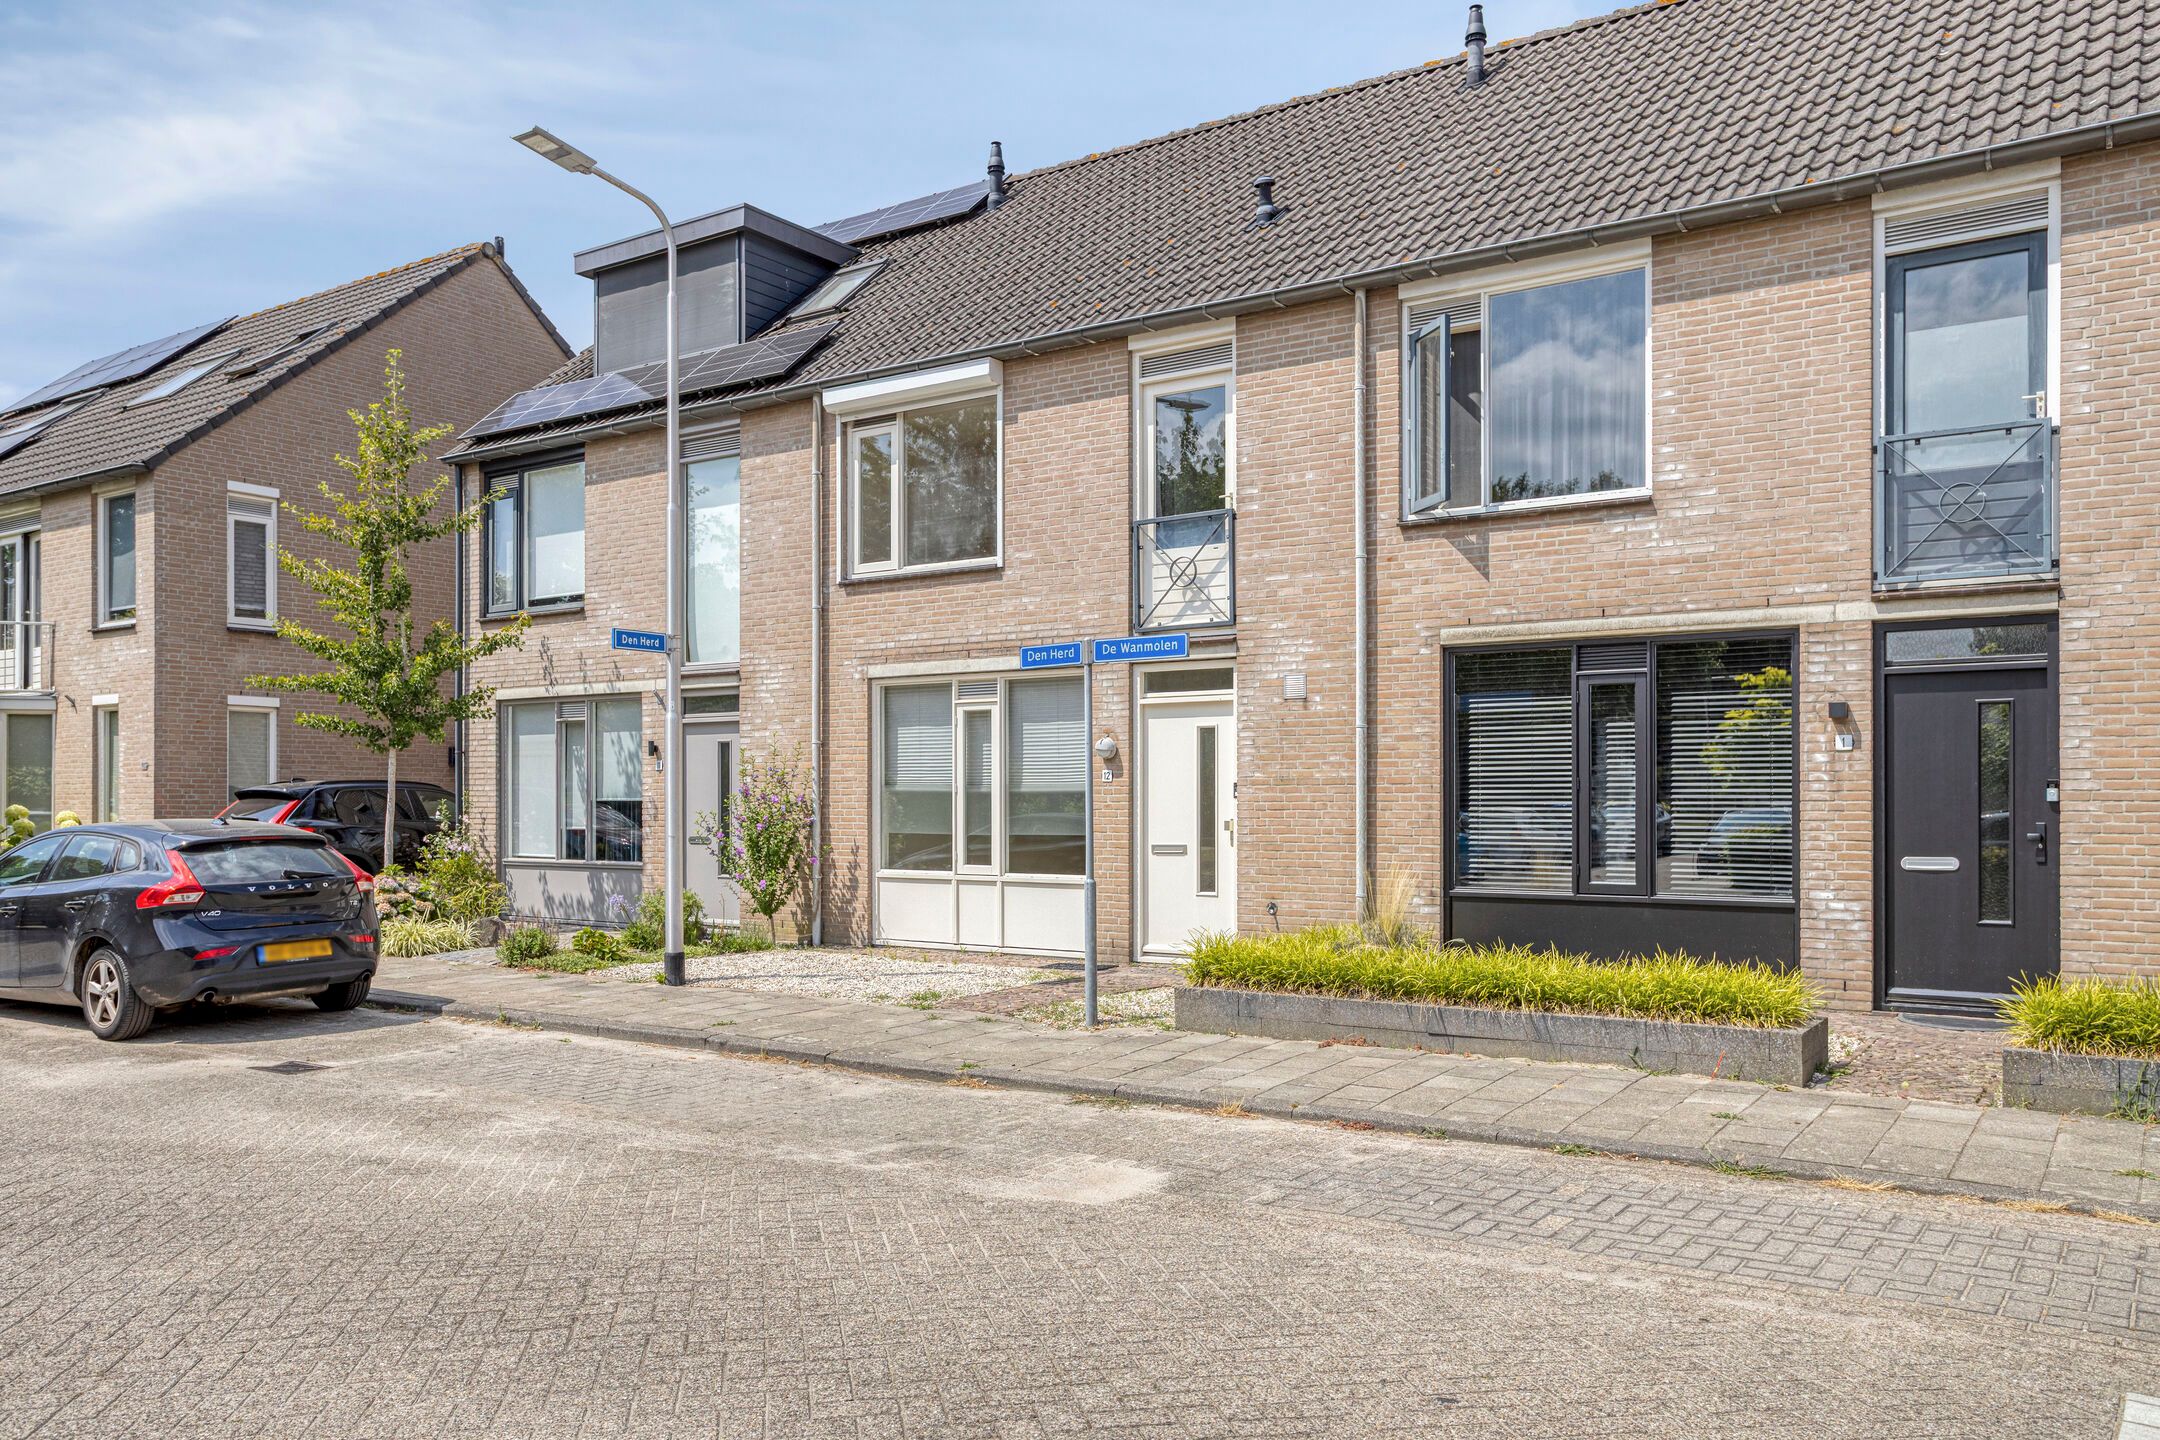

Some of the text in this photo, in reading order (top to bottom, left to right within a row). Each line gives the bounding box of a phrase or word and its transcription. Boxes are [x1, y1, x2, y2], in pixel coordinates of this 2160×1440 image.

[622, 634, 660, 647] Den Herd
[1102, 640, 1178, 655] De Wanmolen
[1027, 646, 1075, 661] Den Herd
[248, 882, 329, 892] VOLVO
